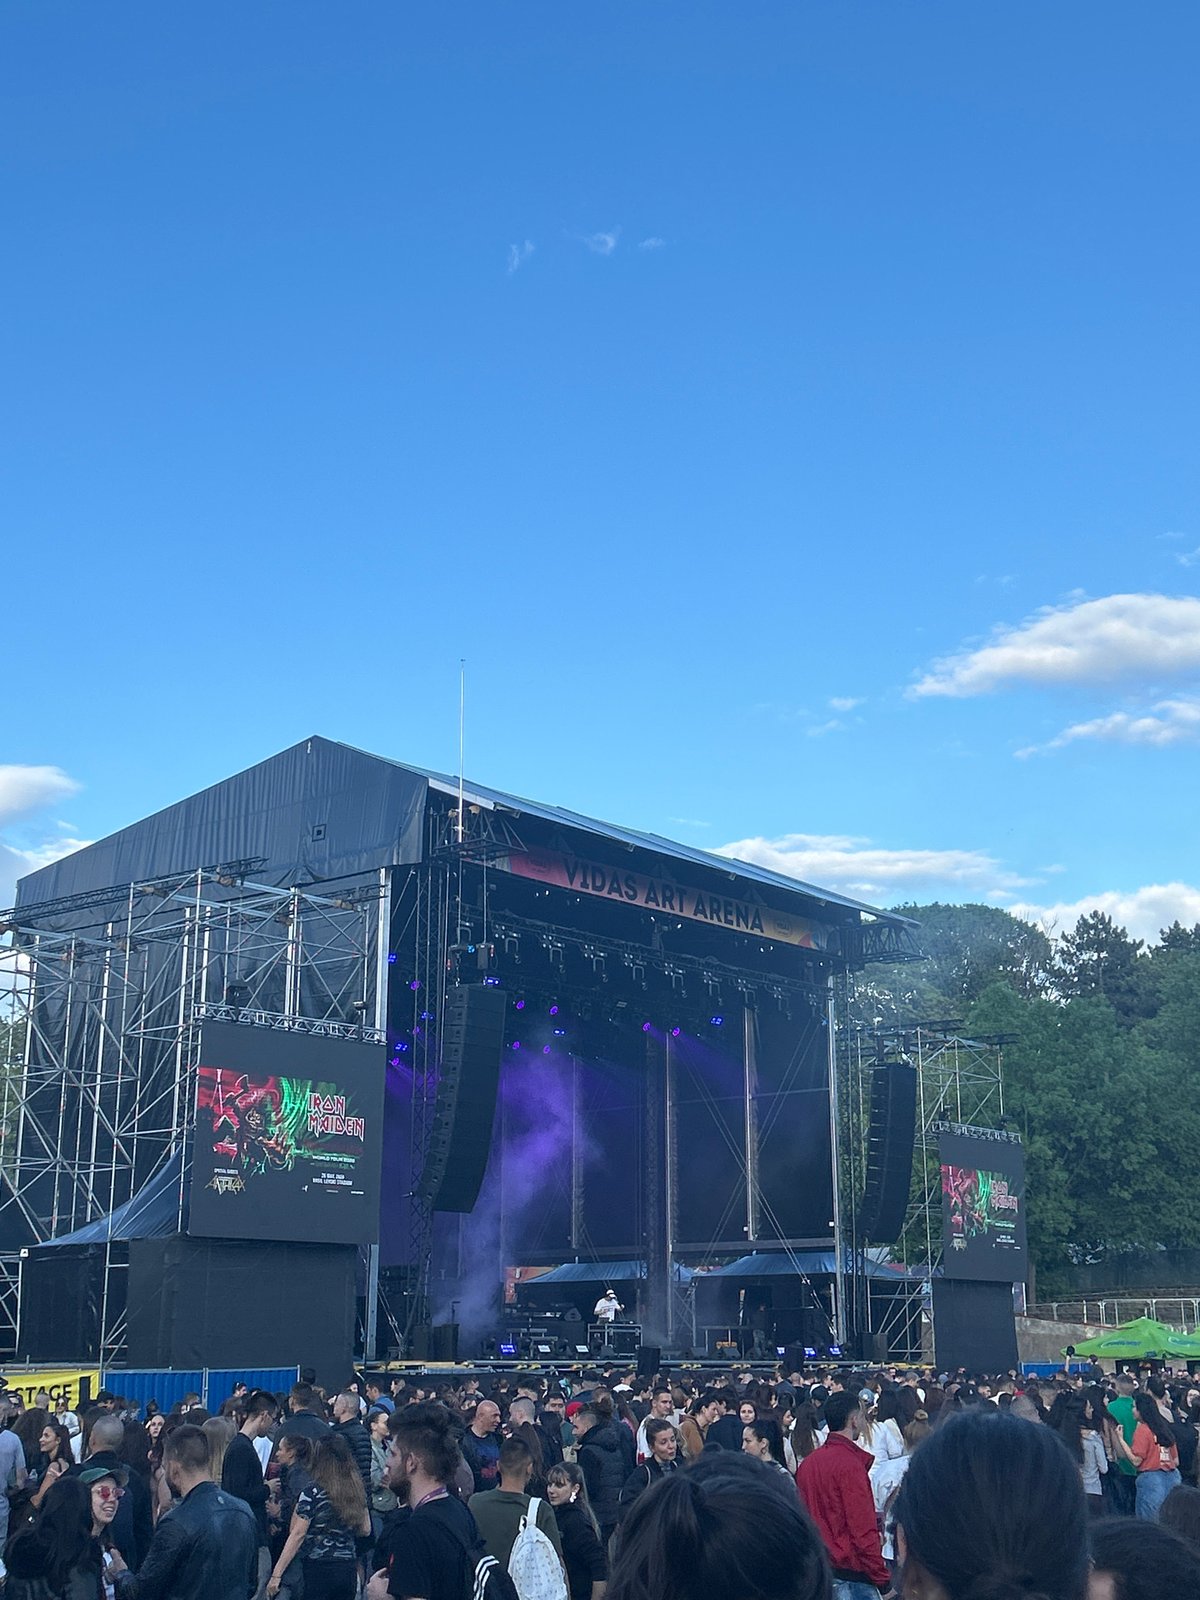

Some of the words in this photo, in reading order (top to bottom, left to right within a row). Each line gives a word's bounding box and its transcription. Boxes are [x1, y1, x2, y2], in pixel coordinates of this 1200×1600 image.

[563, 858, 638, 901] VIDAS
[644, 881, 688, 913] ART
[693, 896, 764, 934] ARENA
[307, 1092, 346, 1121] IRON
[307, 1112, 365, 1143] MAIDEN
